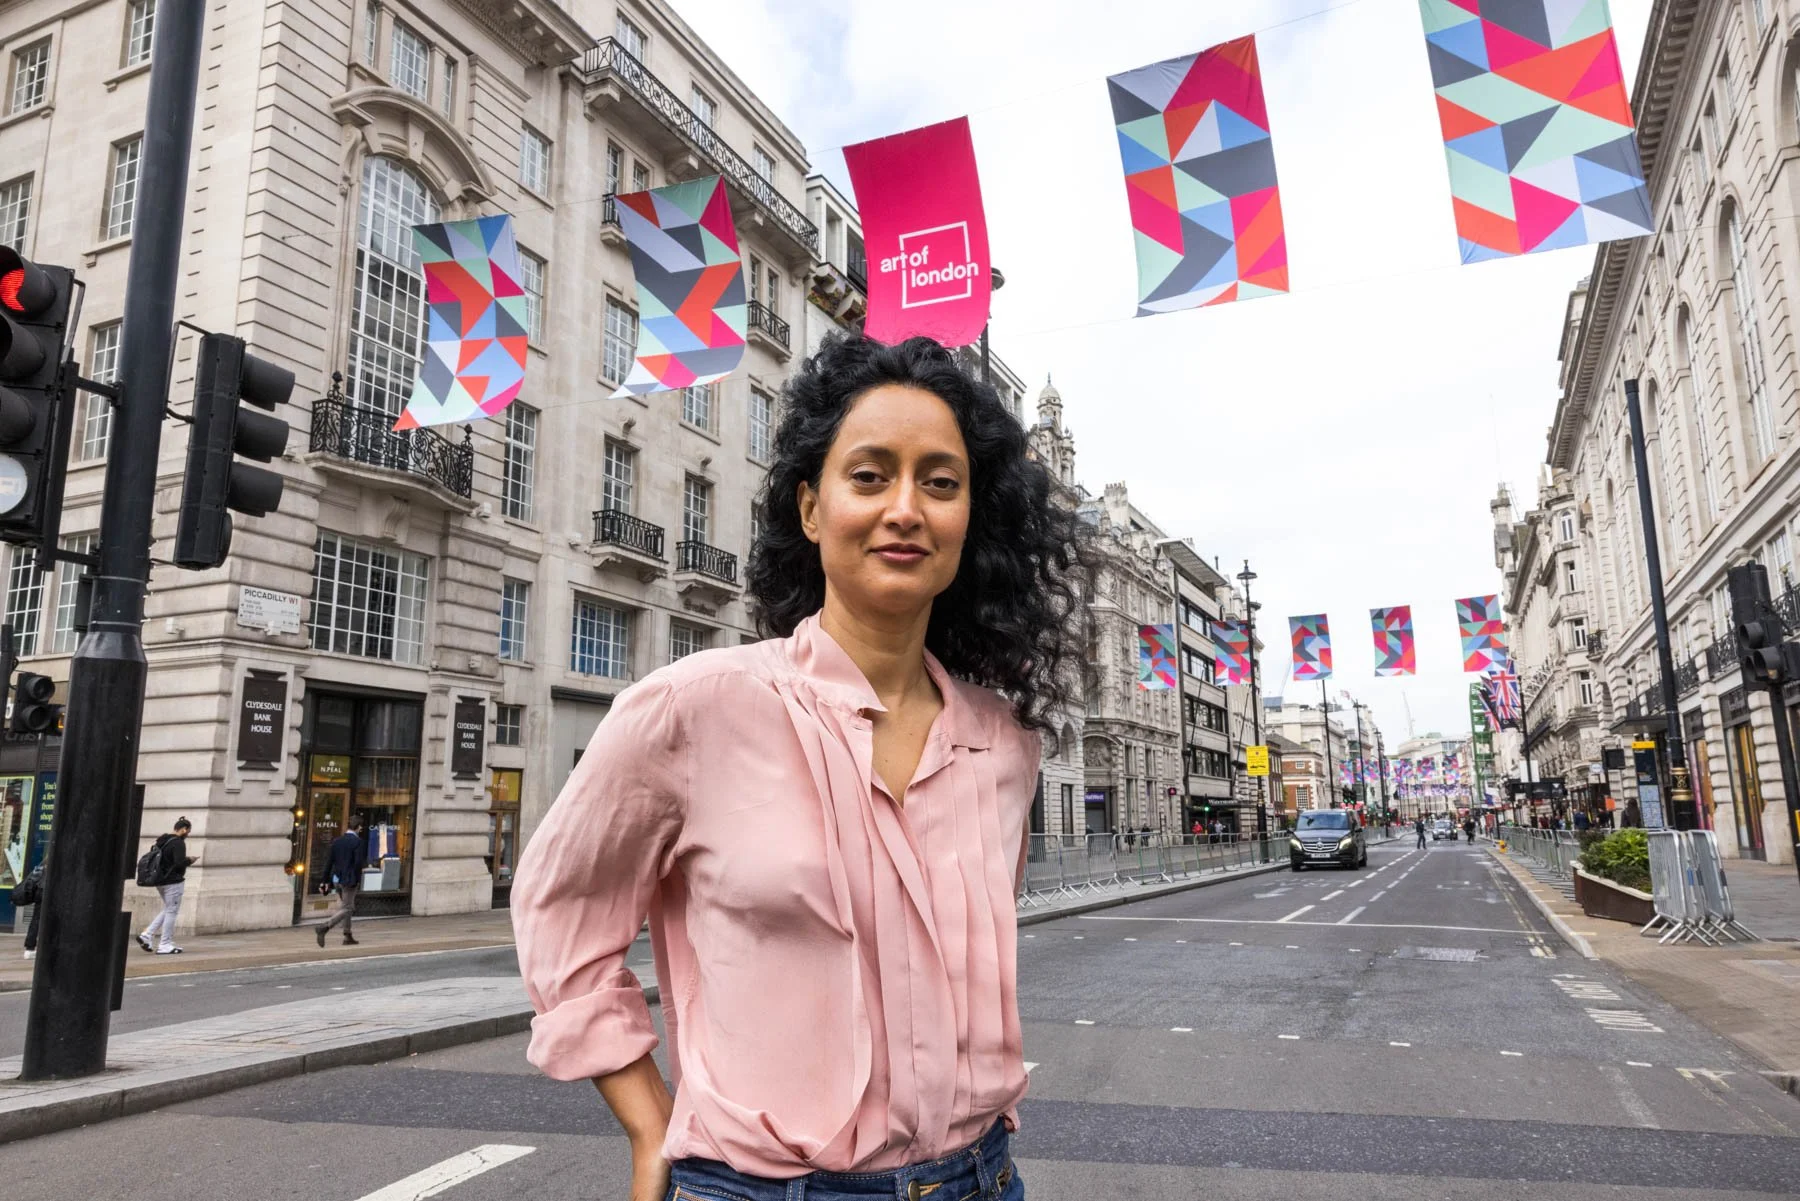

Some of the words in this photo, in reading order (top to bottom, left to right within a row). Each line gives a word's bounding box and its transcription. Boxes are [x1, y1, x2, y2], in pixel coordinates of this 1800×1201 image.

[880, 252, 908, 273] art
[909, 245, 929, 267] of
[911, 261, 979, 288] london
[244, 588, 287, 602] PICCADILLY
[288, 596, 298, 605] W1
[245, 700, 283, 711] CLYDESDALE
[253, 713, 272, 721] BANK
[250, 724, 273, 733] HOUSE
[456, 721, 483, 731] CLYDESDALE
[462, 732, 475, 740] BANK
[460, 741, 476, 749] HOUSE
